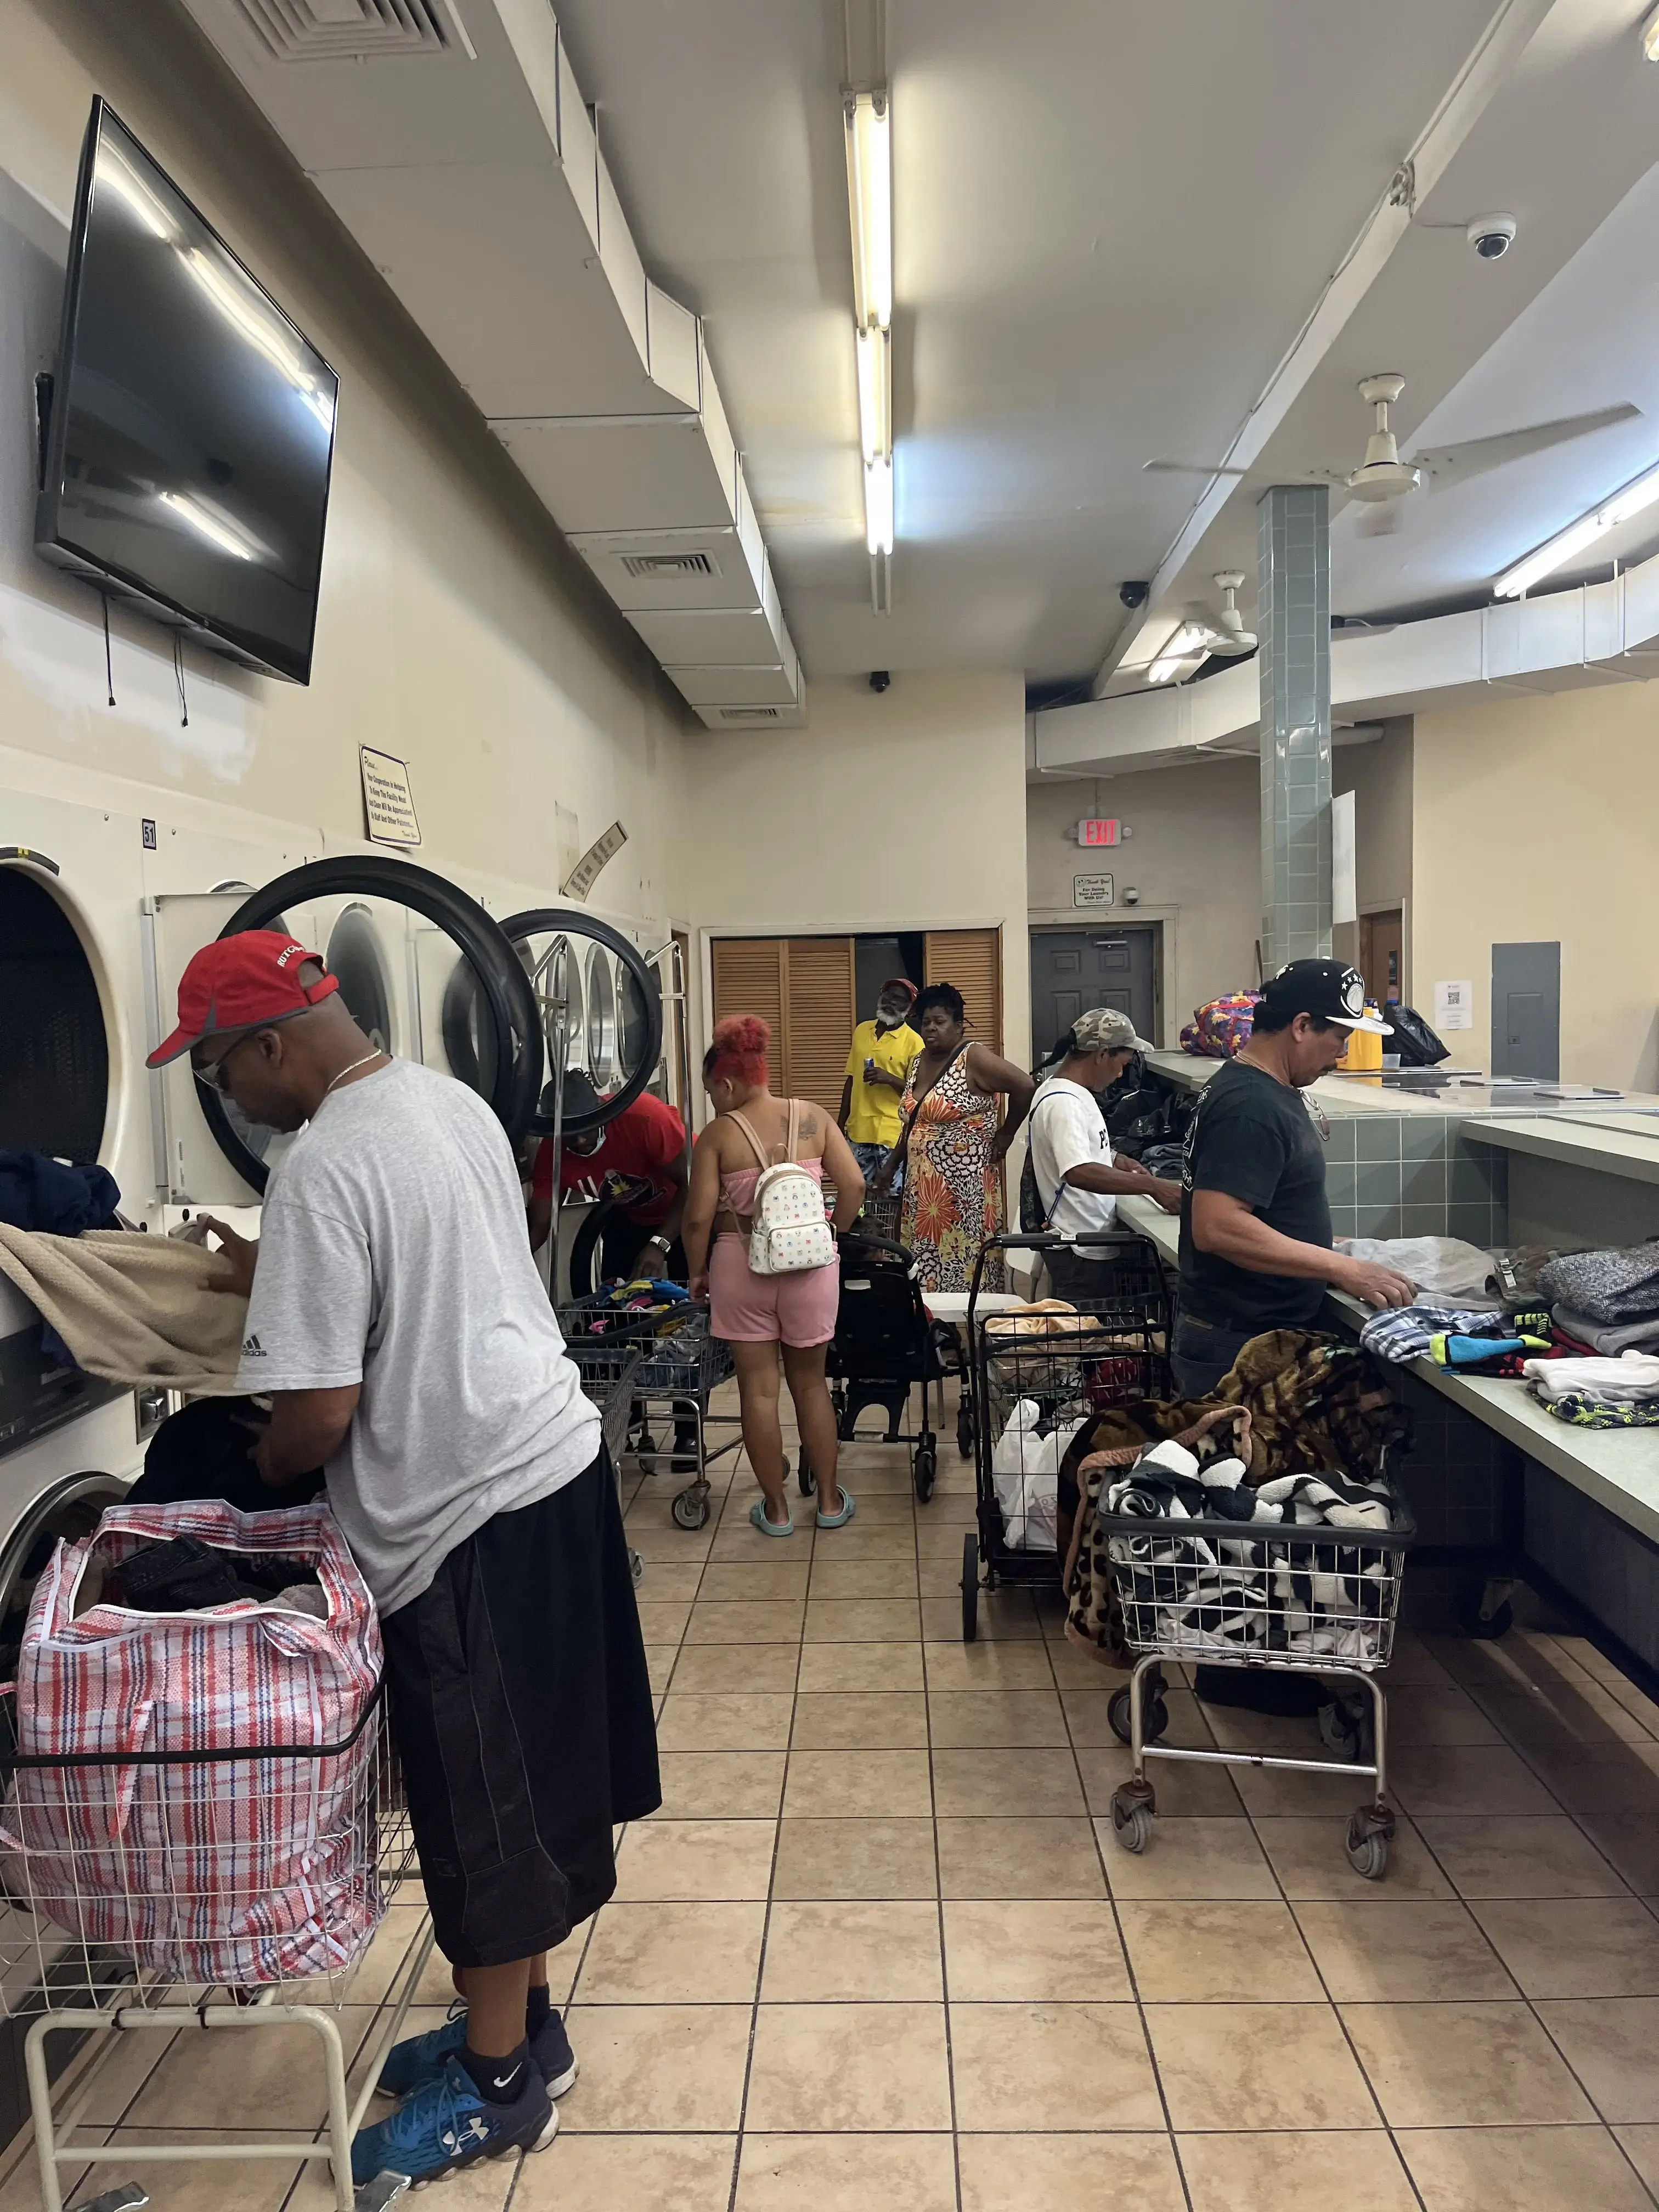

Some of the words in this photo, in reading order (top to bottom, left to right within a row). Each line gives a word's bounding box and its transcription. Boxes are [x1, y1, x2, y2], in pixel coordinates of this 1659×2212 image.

[145, 826, 154, 843] 51
[1087, 820, 1116, 844] EXIT
[277, 945, 307, 967] RUTG
